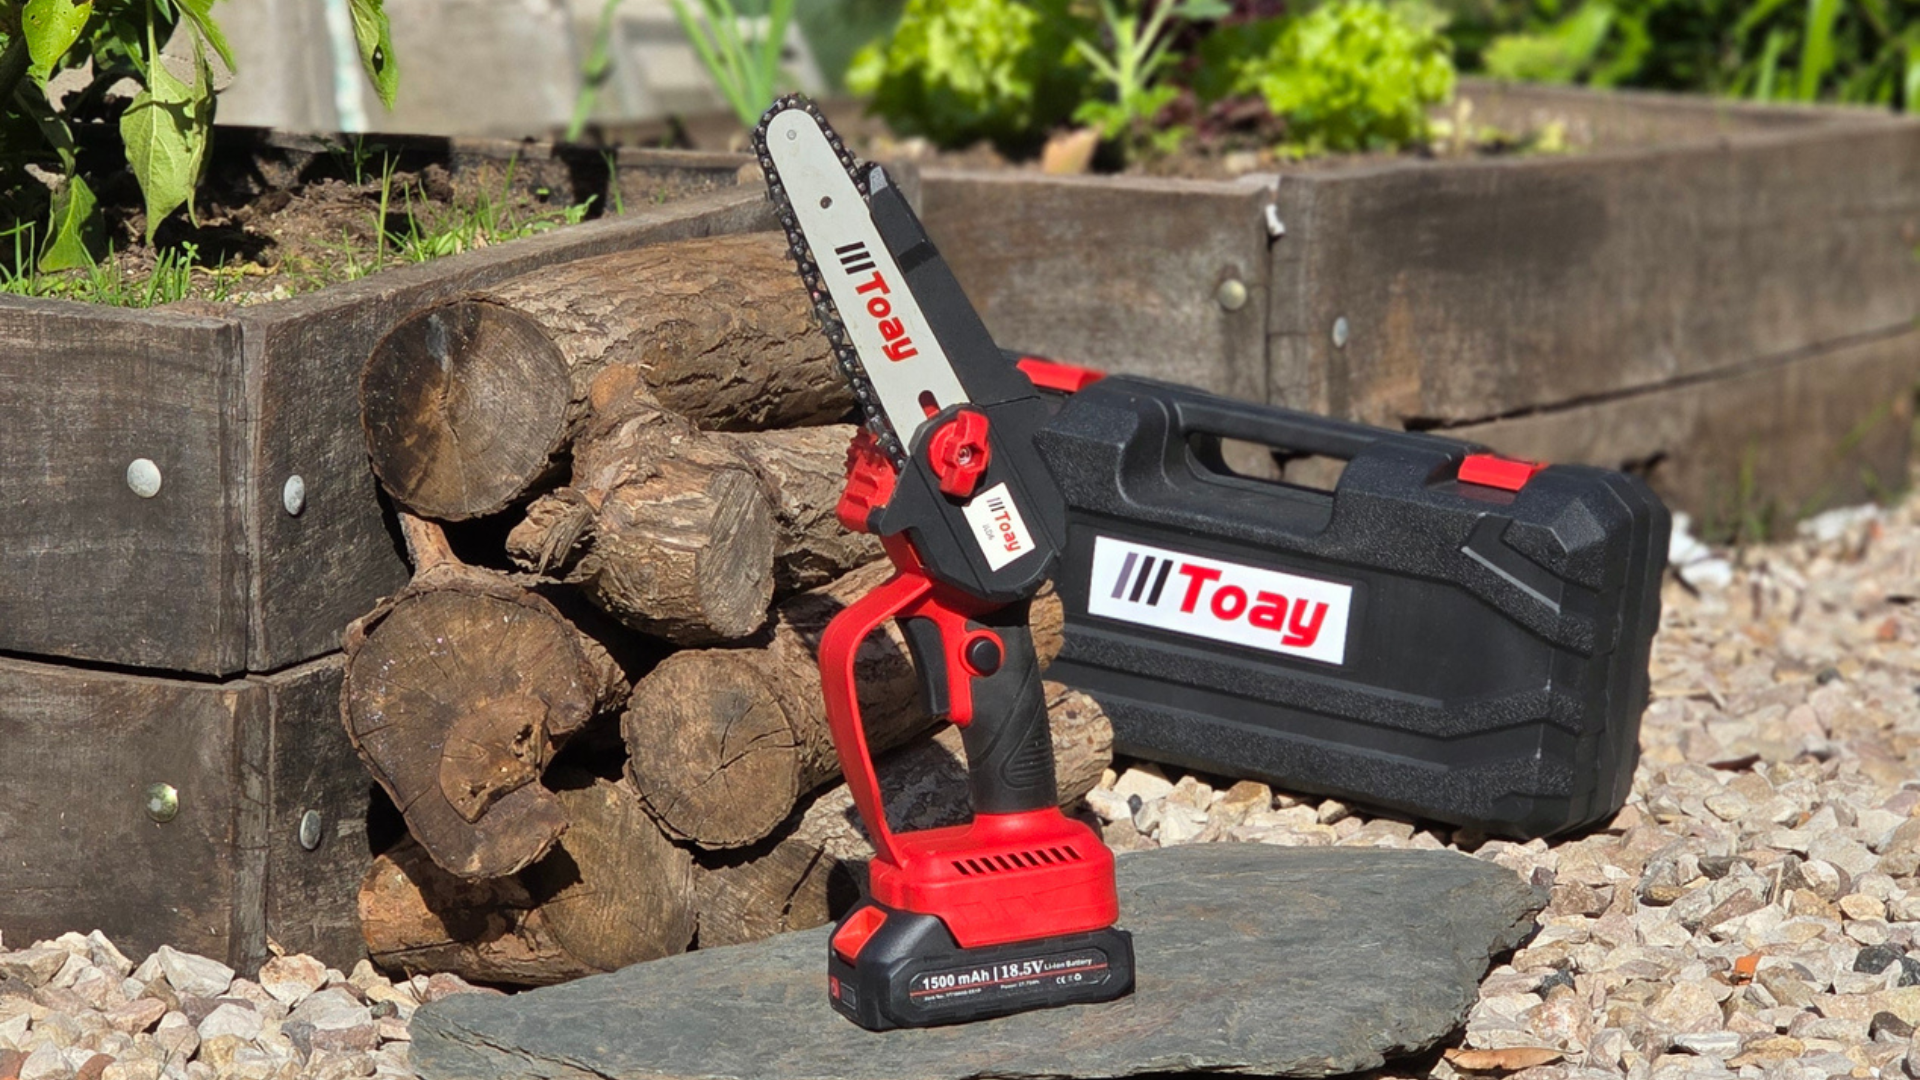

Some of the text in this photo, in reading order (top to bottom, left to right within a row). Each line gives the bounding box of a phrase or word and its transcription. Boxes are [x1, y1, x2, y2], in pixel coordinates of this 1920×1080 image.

[855, 270, 919, 362] Toay
[994, 510, 1021, 552] Toay
[1179, 562, 1330, 648] Toay
[922, 973, 956, 990] 1500
[957, 970, 990, 985] mAh
[1001, 959, 1044, 979] 18.5V
